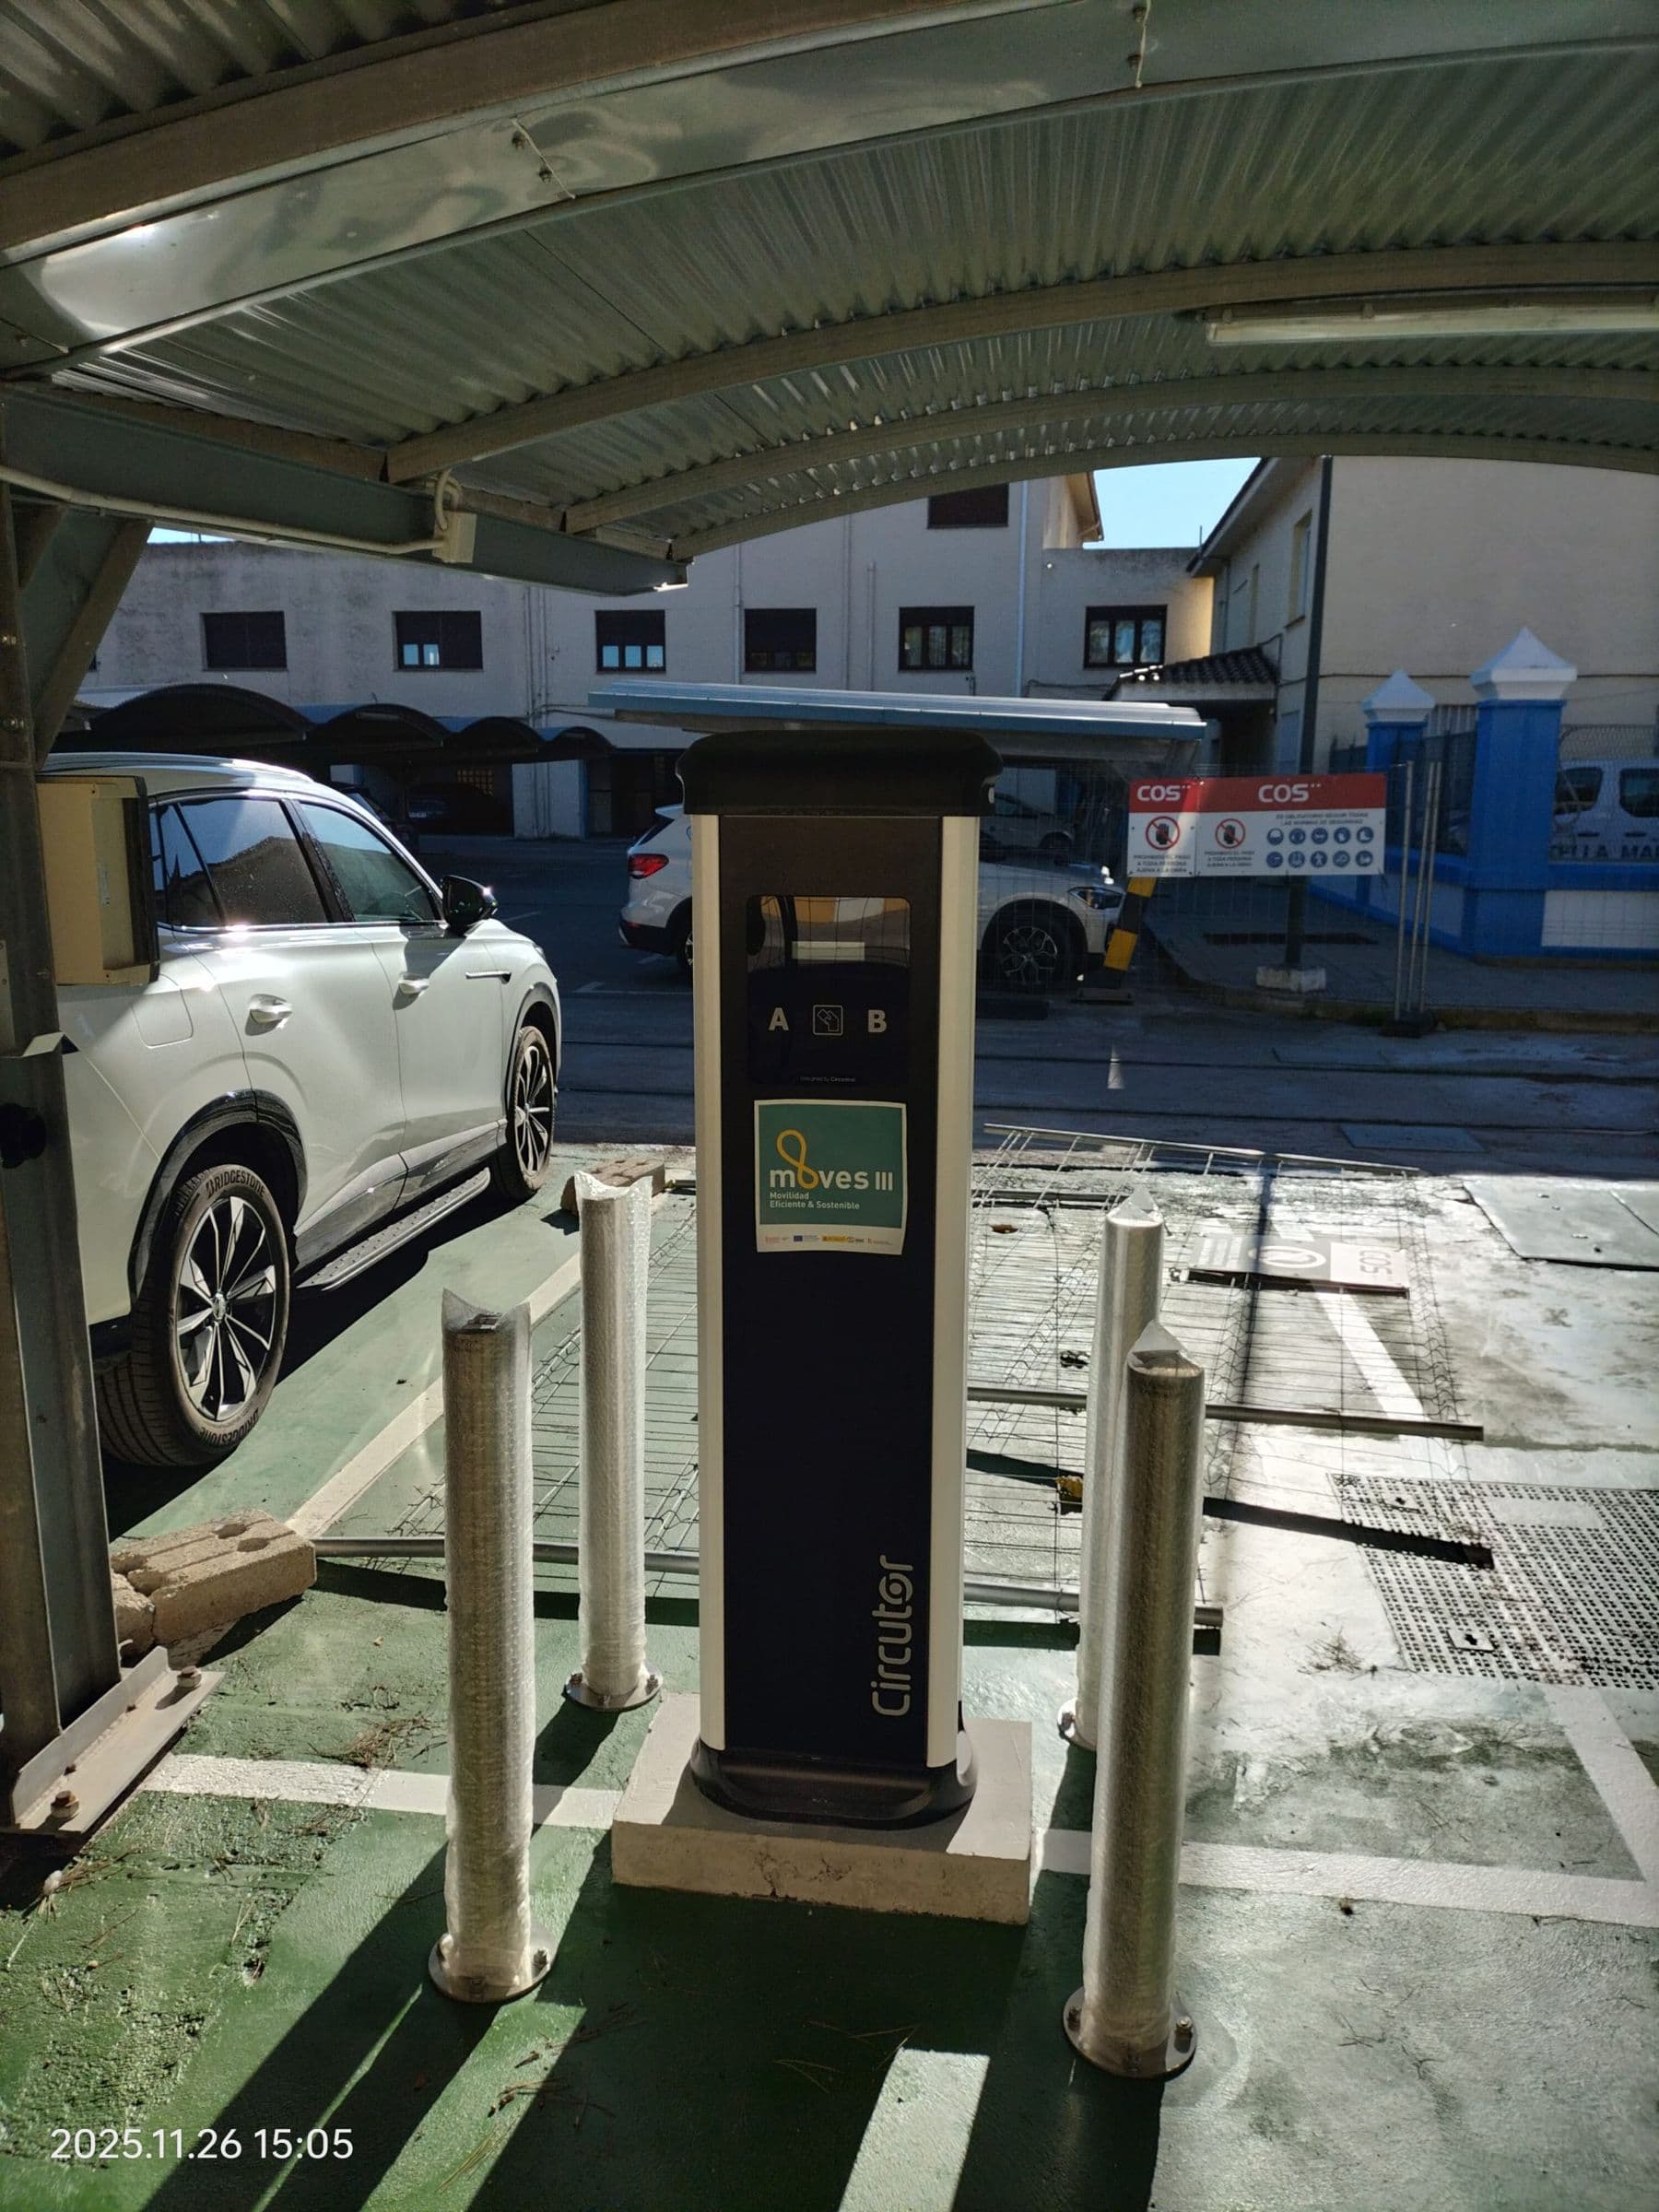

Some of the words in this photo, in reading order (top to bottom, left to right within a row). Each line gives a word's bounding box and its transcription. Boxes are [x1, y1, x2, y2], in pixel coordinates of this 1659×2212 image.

[1137, 784, 1182, 802] COS
[1257, 783, 1310, 803] COS
[768, 1006, 790, 1031] A
[867, 1009, 888, 1033] B
[206, 1170, 265, 1199] BRIDGESTONE
[770, 1191, 809, 1200] Movilidad
[770, 1200, 806, 1208] Eficiente
[807, 1200, 815, 1208] &
[816, 1200, 860, 1210] Sostenible
[870, 1554, 914, 1717] Circutor
